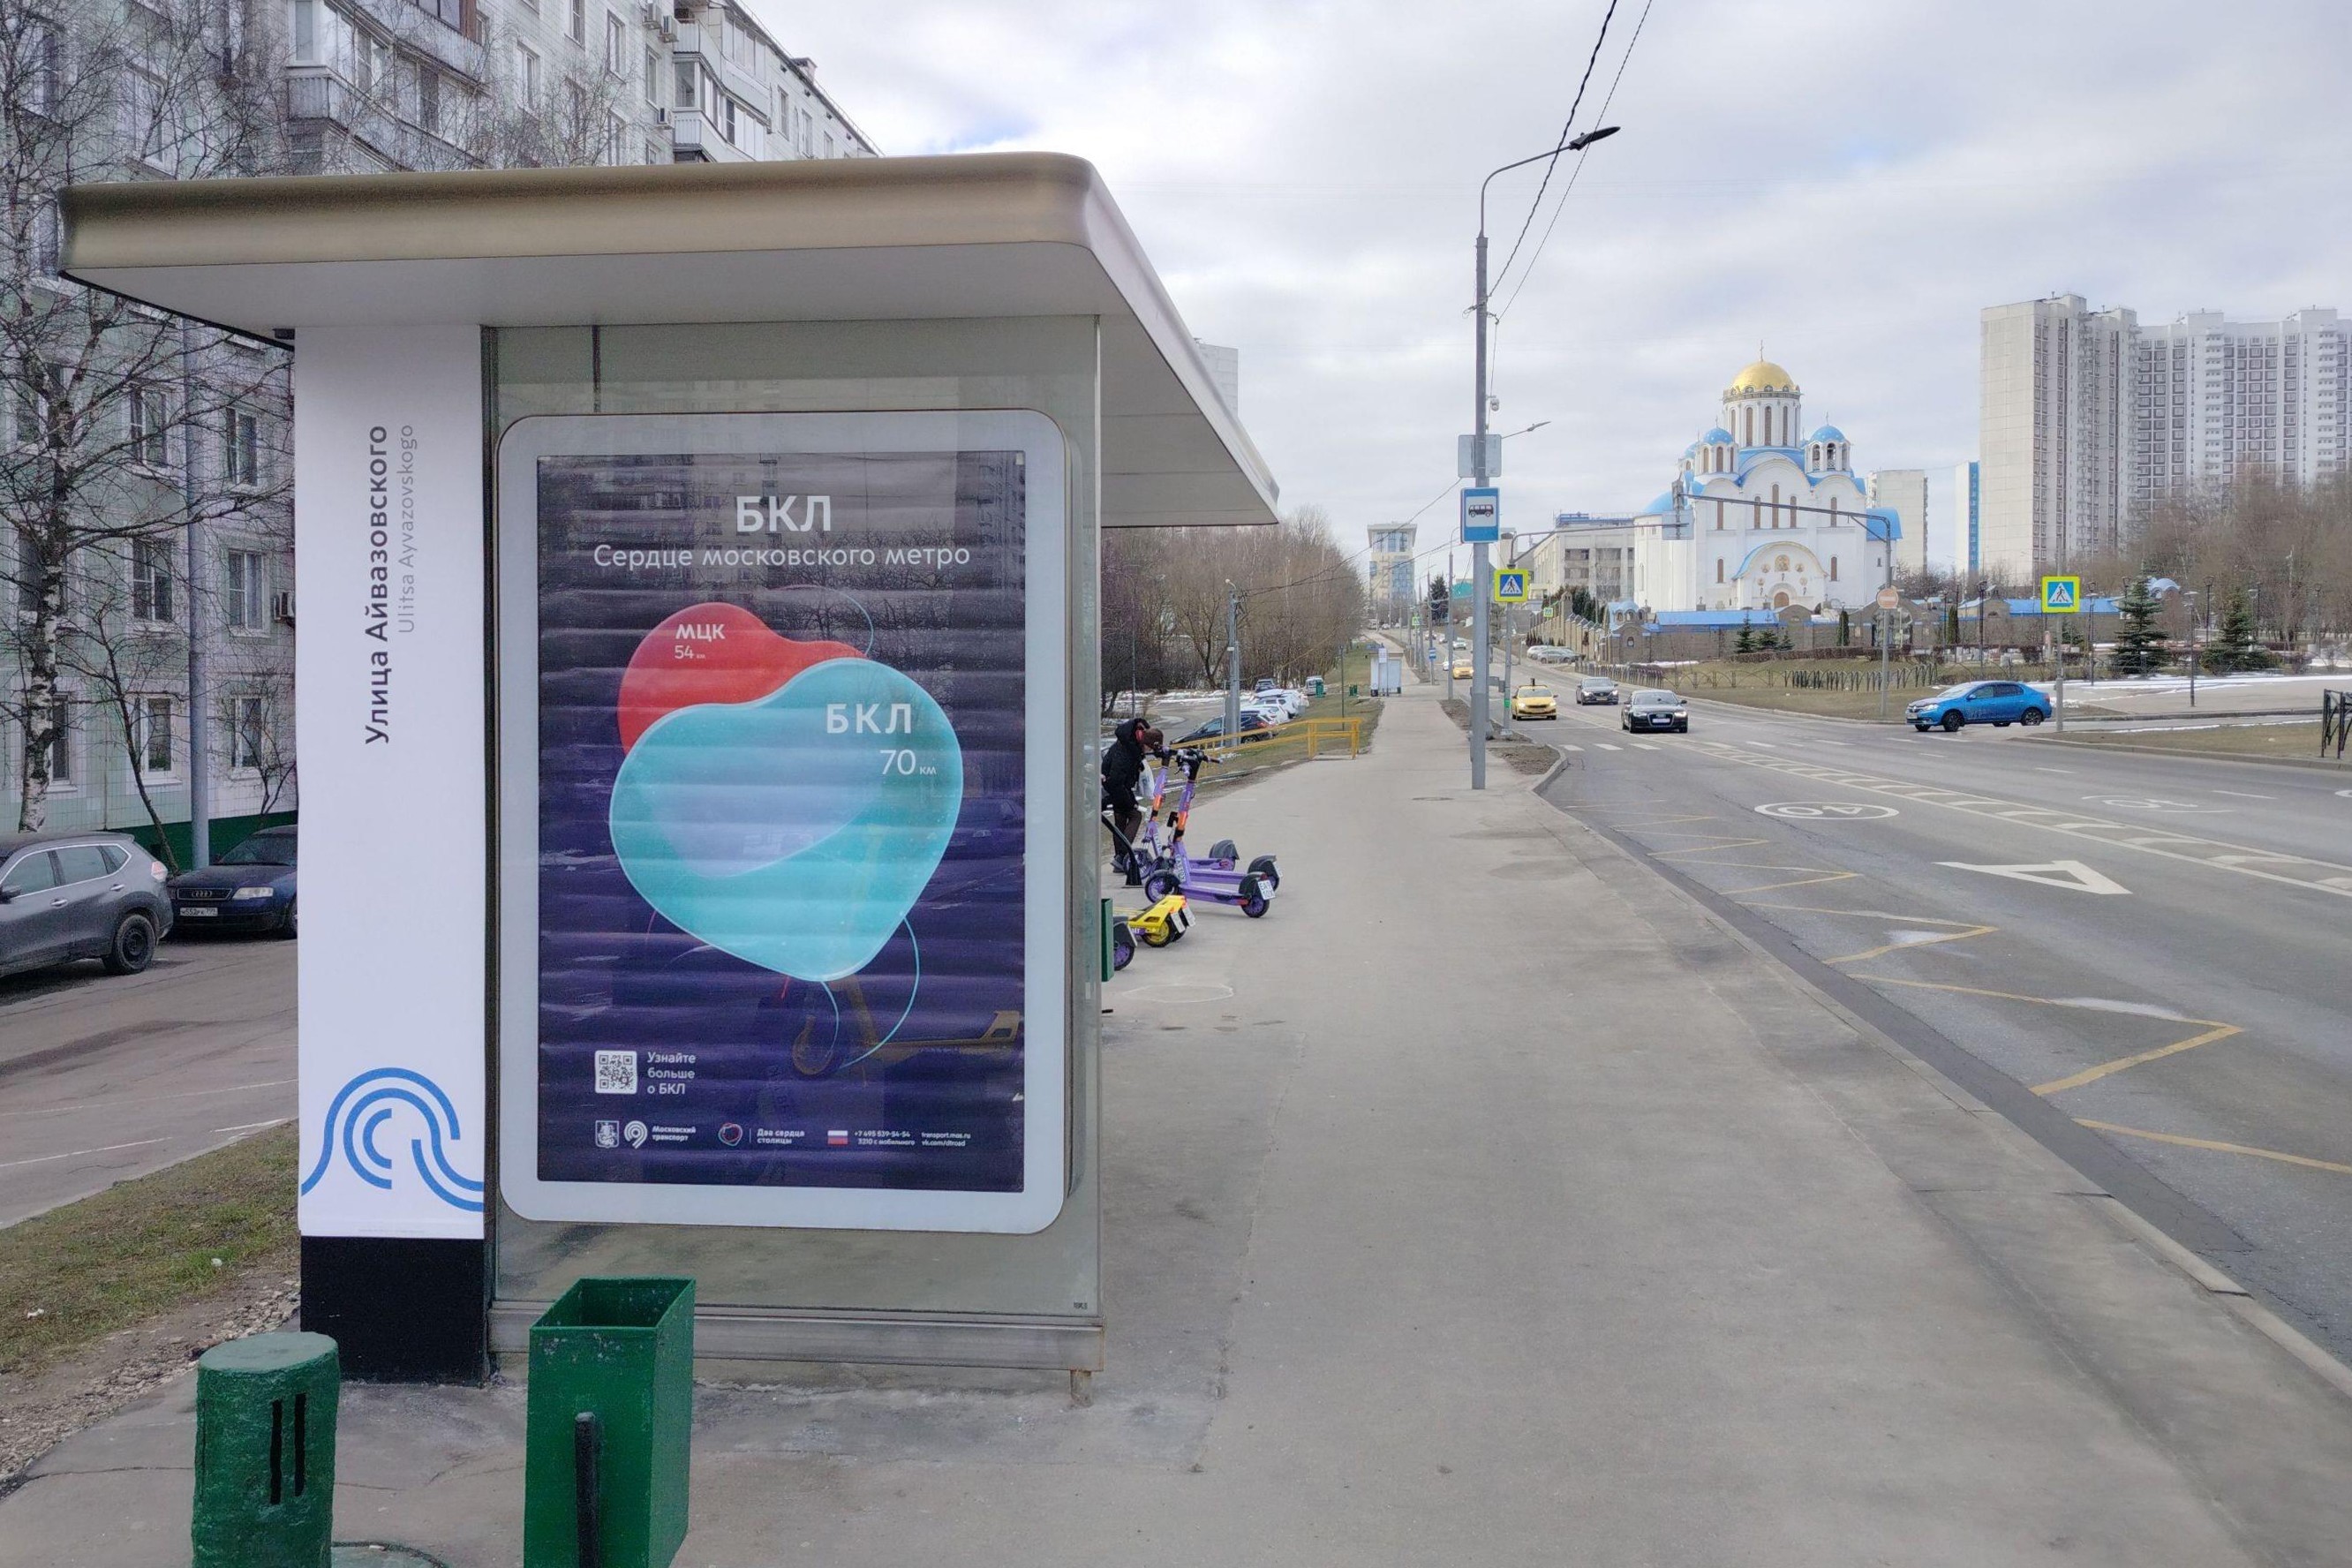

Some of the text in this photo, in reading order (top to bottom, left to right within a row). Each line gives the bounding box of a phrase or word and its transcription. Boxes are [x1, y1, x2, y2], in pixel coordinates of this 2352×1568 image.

[735, 494, 832, 532] БКЛ
[396, 424, 418, 634] Ulitsa Ayvazovskogo
[593, 543, 970, 571] Сердце московского метро
[365, 426, 392, 745] Улица Айвазовского
[675, 623, 726, 643] МЦК
[675, 645, 694, 660] 54
[826, 704, 912, 735] БКЛ
[880, 750, 937, 776] 70 км
[647, 1052, 696, 1064] Узнайте
[647, 1067, 695, 1079] больше
[659, 1083, 685, 1095] БКЛ
[757, 1128, 773, 1137] Два
